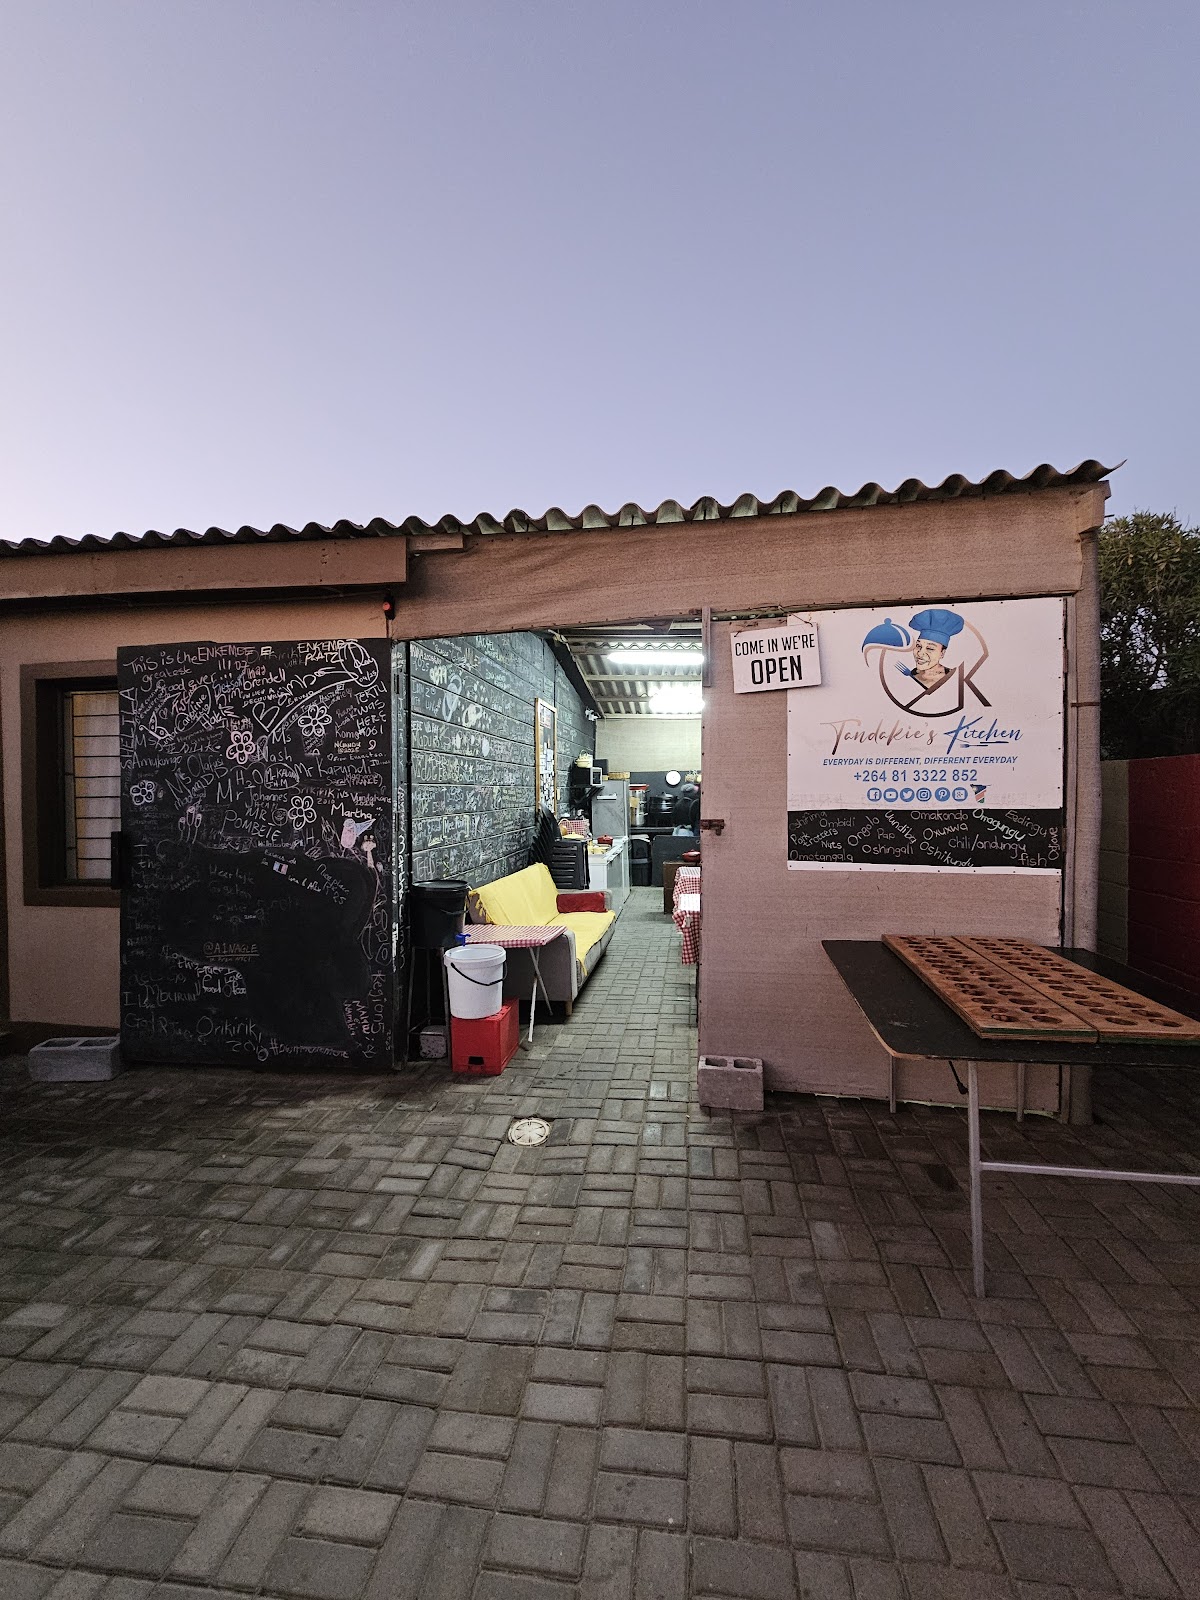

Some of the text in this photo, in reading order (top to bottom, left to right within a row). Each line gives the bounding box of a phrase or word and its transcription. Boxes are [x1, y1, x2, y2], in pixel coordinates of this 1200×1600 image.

[735, 633, 815, 656] COME IN WE'RE
[751, 655, 802, 684] OPEN
[820, 715, 1024, 755] Tandakie's Kitchen
[823, 755, 1018, 766] EVERYDAY IS DIFFERENT, DIFFERENT EVERYDAY
[854, 769, 978, 782] +264 81 3322 852
[876, 827, 895, 840] Pap
[1018, 852, 1048, 867] fish
